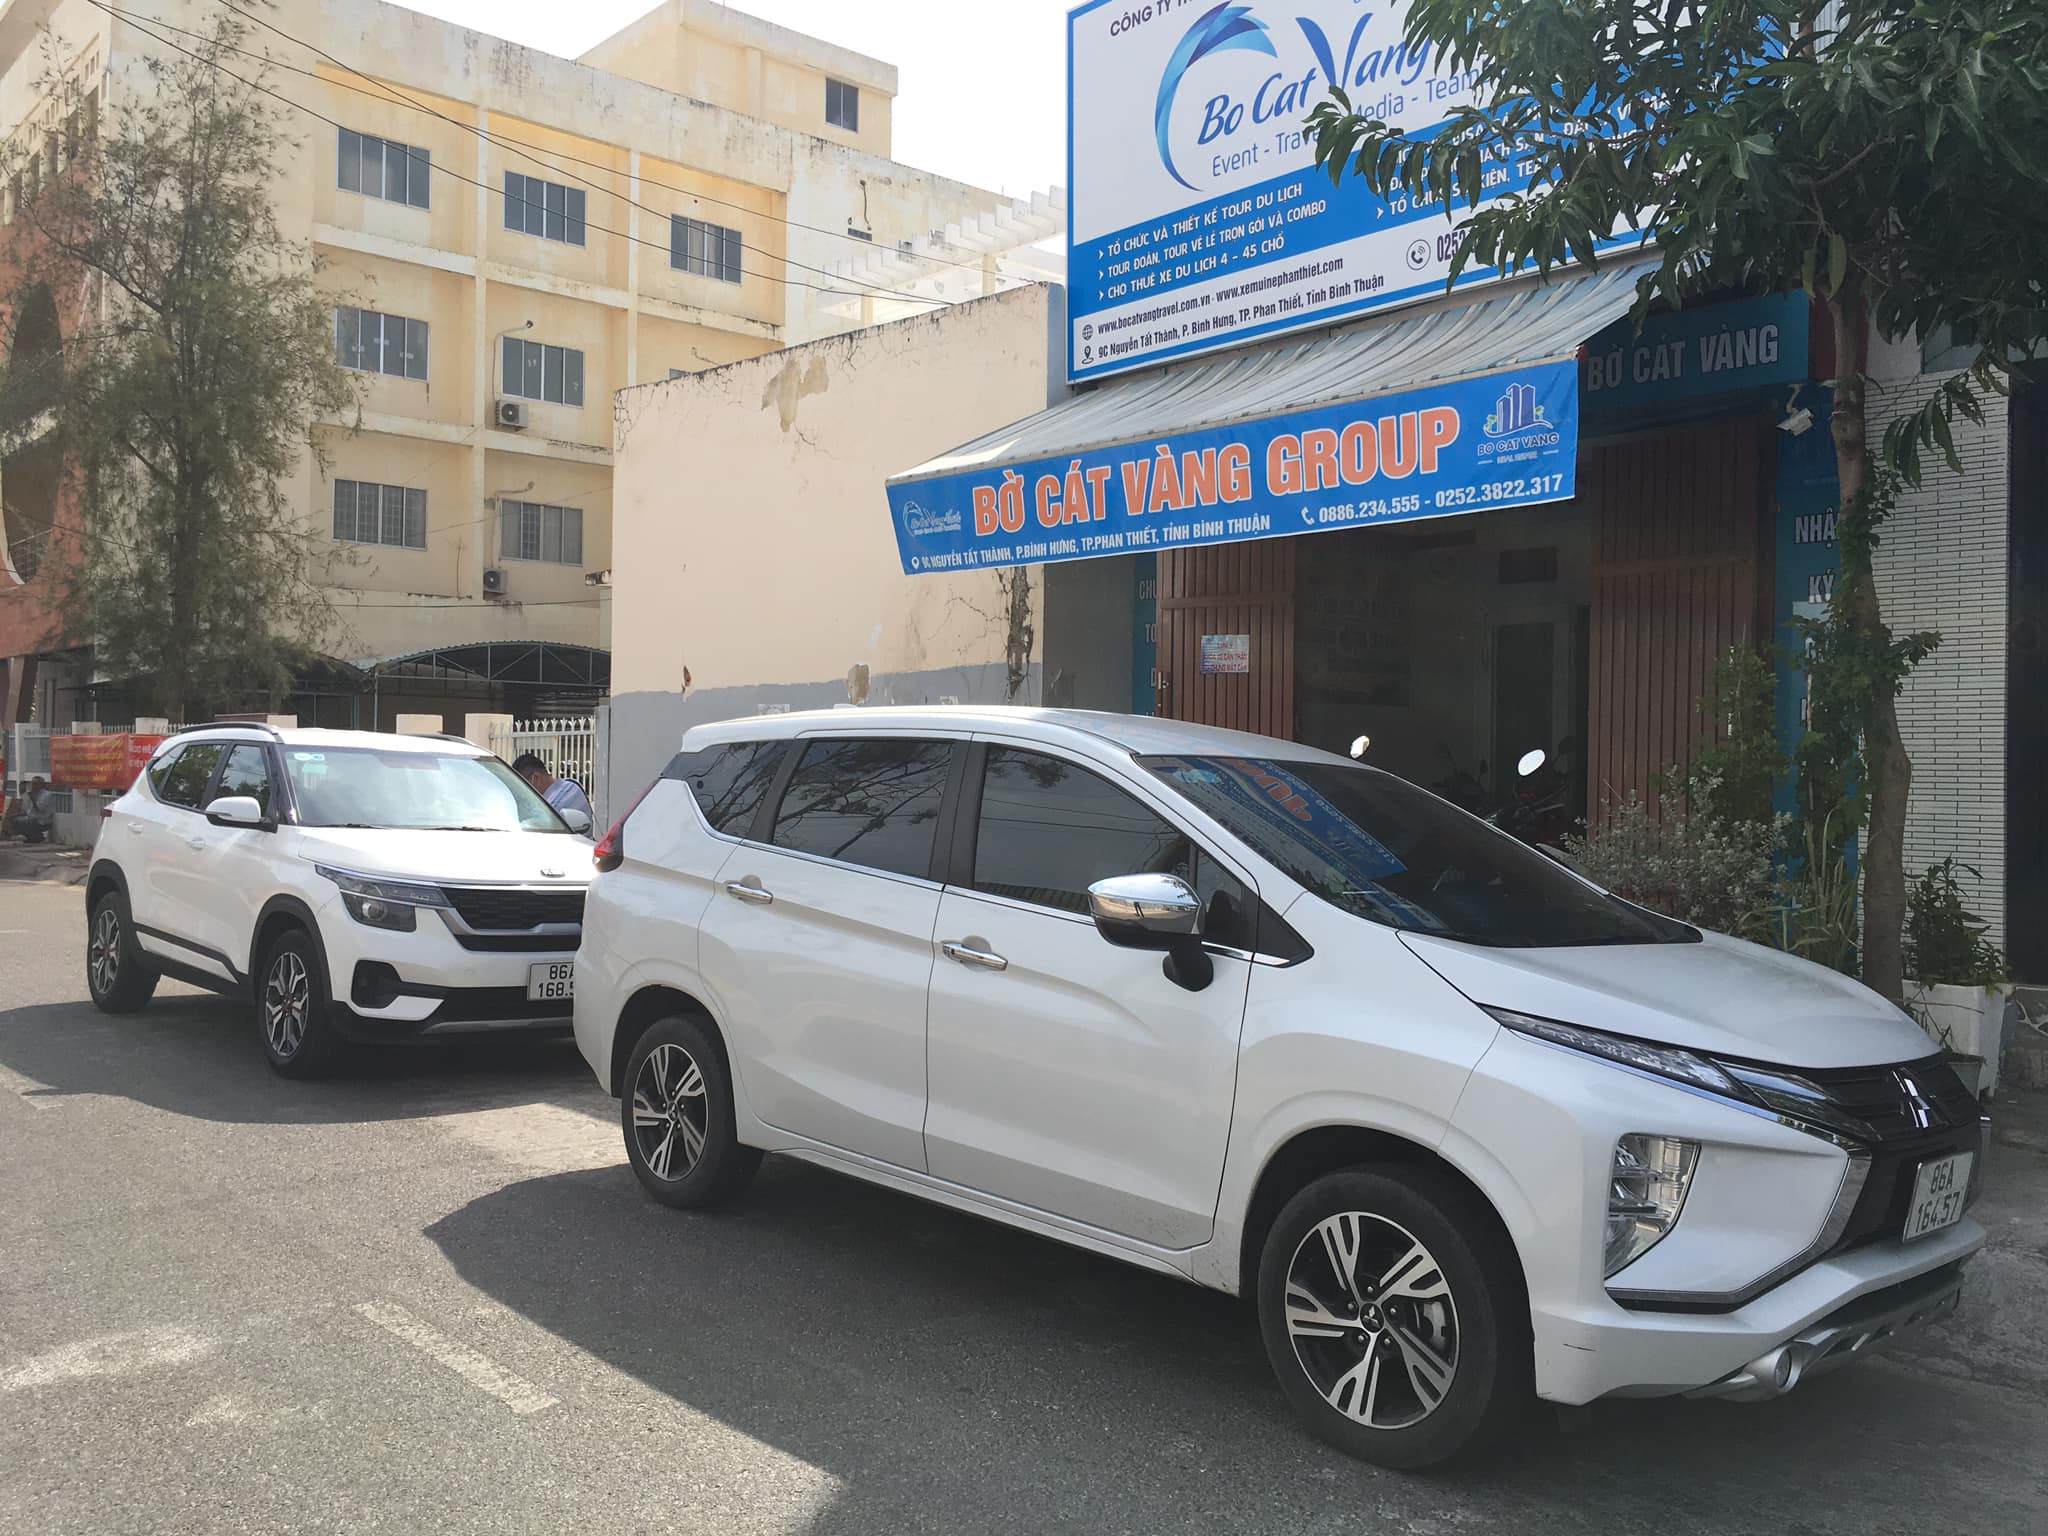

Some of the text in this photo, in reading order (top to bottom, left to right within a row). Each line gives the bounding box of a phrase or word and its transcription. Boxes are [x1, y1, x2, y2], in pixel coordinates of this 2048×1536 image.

[1110, 6, 1153, 36] CÔNG
[1197, 12, 1432, 145] Bo Cat Vang
[1212, 143, 1258, 177] Event
[1107, 183, 1303, 257] TỔ CHỨC VÀ THIẾT KẾ TOUR DU LỊCH
[1107, 260, 1130, 278] TOUR
[1163, 242, 1188, 260] TOUR
[1219, 224, 1245, 244] TRỌN
[1248, 216, 1265, 235] GÓI
[1268, 210, 1284, 228] VÀ
[1287, 199, 1326, 223] COMBO
[1097, 294, 1211, 335] www.bocatvangtravel.com.vn
[1216, 257, 1344, 303] www.xemuinephanthiet.com
[1107, 283, 1127, 299] CHO
[1131, 272, 1156, 292] THUÊ
[1159, 269, 1172, 284] XE
[1175, 263, 1191, 280] DU
[1194, 255, 1217, 275] LỊCH
[1220, 252, 1228, 265] 4
[1242, 243, 1257, 259] 45
[1110, 333, 1139, 356] Nguyễn
[1140, 330, 1153, 348] Tất
[1154, 327, 1181, 345] Thành,
[1182, 324, 1190, 337] P.
[1192, 319, 1211, 335] Bình
[1212, 313, 1237, 330] Hưng,
[1239, 307, 1251, 323] TP.
[1253, 303, 1277, 319] Phan
[1278, 292, 1304, 313] Thiết,
[1329, 281, 1351, 300] Bình
[1353, 274, 1385, 294] Thuận
[1586, 323, 1779, 392] BỜ CÁT VÀNG
[1477, 431, 1560, 457] BO CAT VANG
[971, 406, 1461, 537] BỜ CÁT VÀNG GROUP
[1318, 493, 1420, 524] 0886.234.555
[1435, 474, 1563, 508] 0252.3822.317
[964, 546, 978, 565] TẤT
[980, 547, 1014, 564] THÀNH,
[1015, 541, 1047, 560] P.BÌNH
[1049, 538, 1080, 555] HƯNG,
[1081, 532, 1123, 551] TP.PHAN
[1125, 523, 1160, 546] THIẾT,
[1193, 519, 1224, 538] BÌNH
[1226, 513, 1271, 535] THUẬN
[1794, 507, 1840, 549] NHẬ
[1930, 1159, 1955, 1195] 86A
[1915, 1191, 1961, 1233] 164.57
